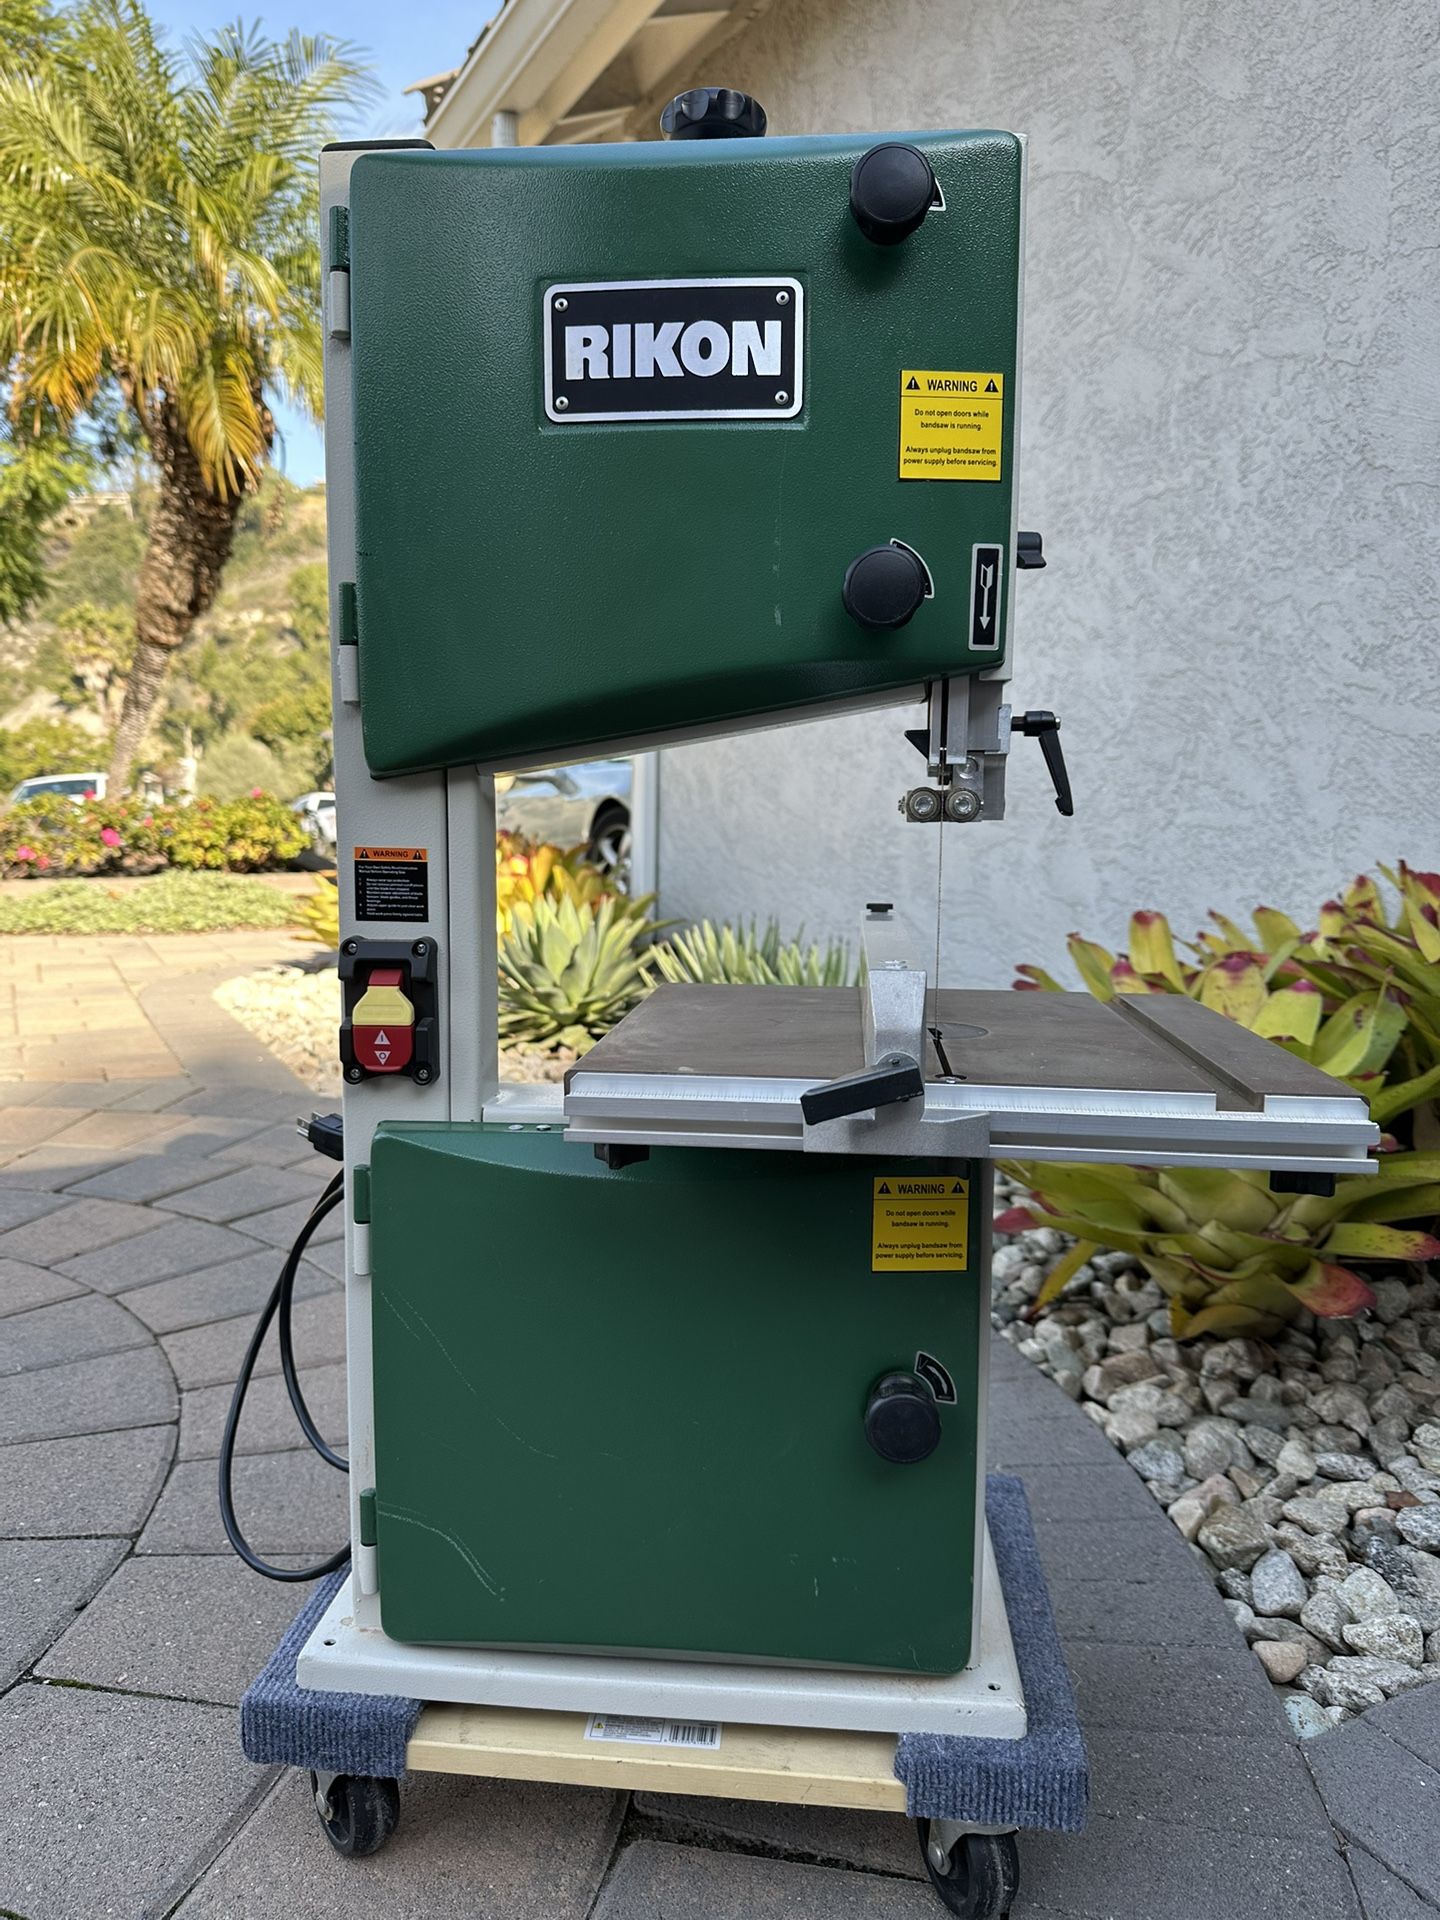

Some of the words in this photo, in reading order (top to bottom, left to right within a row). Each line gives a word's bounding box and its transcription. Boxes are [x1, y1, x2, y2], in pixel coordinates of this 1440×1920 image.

[565, 320, 782, 380] RIKON
[927, 379, 977, 392] WARNING
[936, 410, 952, 418] open
[906, 446, 928, 454] Always
[929, 447, 951, 455] unplug
[898, 1184, 945, 1194] WARNING
[907, 1210, 920, 1218] open
